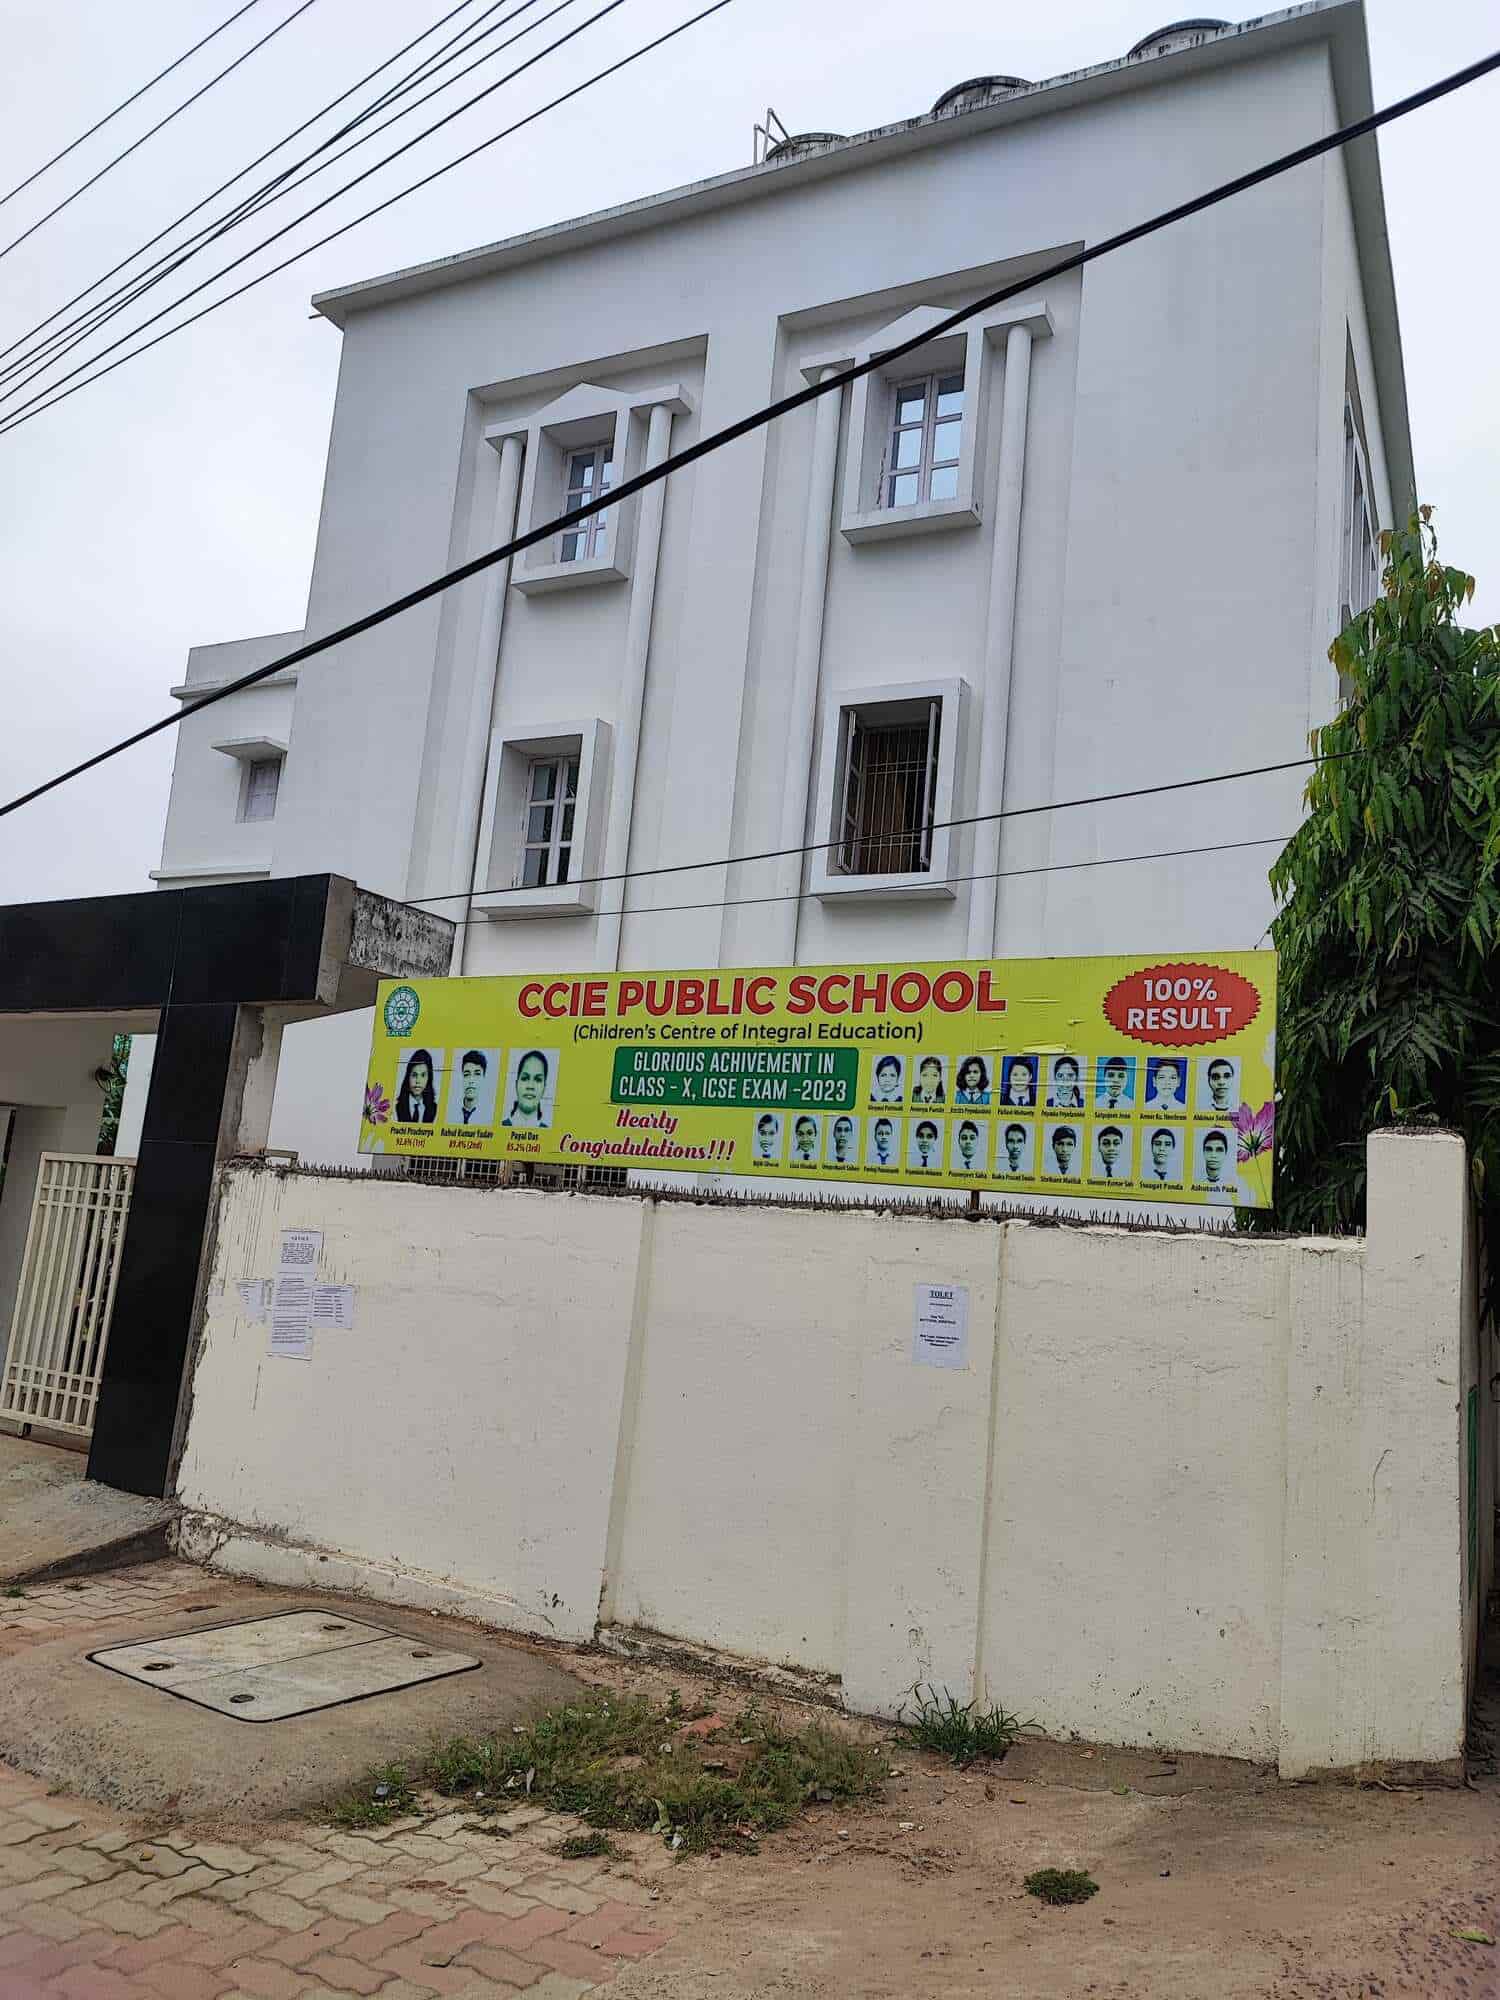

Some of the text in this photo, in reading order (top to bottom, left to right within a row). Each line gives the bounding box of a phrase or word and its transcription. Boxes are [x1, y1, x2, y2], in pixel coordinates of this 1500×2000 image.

[518, 970, 1007, 1017] CCIE PUBLIC SCHOOL
[1143, 978, 1217, 1002] 100%
[1127, 1007, 1232, 1030] RESULT
[574, 1022, 923, 1043] (Children's Centre of Integral Education)
[634, 1051, 835, 1074] GLORIOUS ACHIVEMENT IN
[619, 1076, 665, 1097] CLASS
[682, 1078, 697, 1101] X,
[702, 1078, 737, 1099] ICSE
[742, 1079, 787, 1100] EXAM
[615, 1108, 679, 1135] Hearty
[559, 1132, 736, 1161] Congratulations!!!
